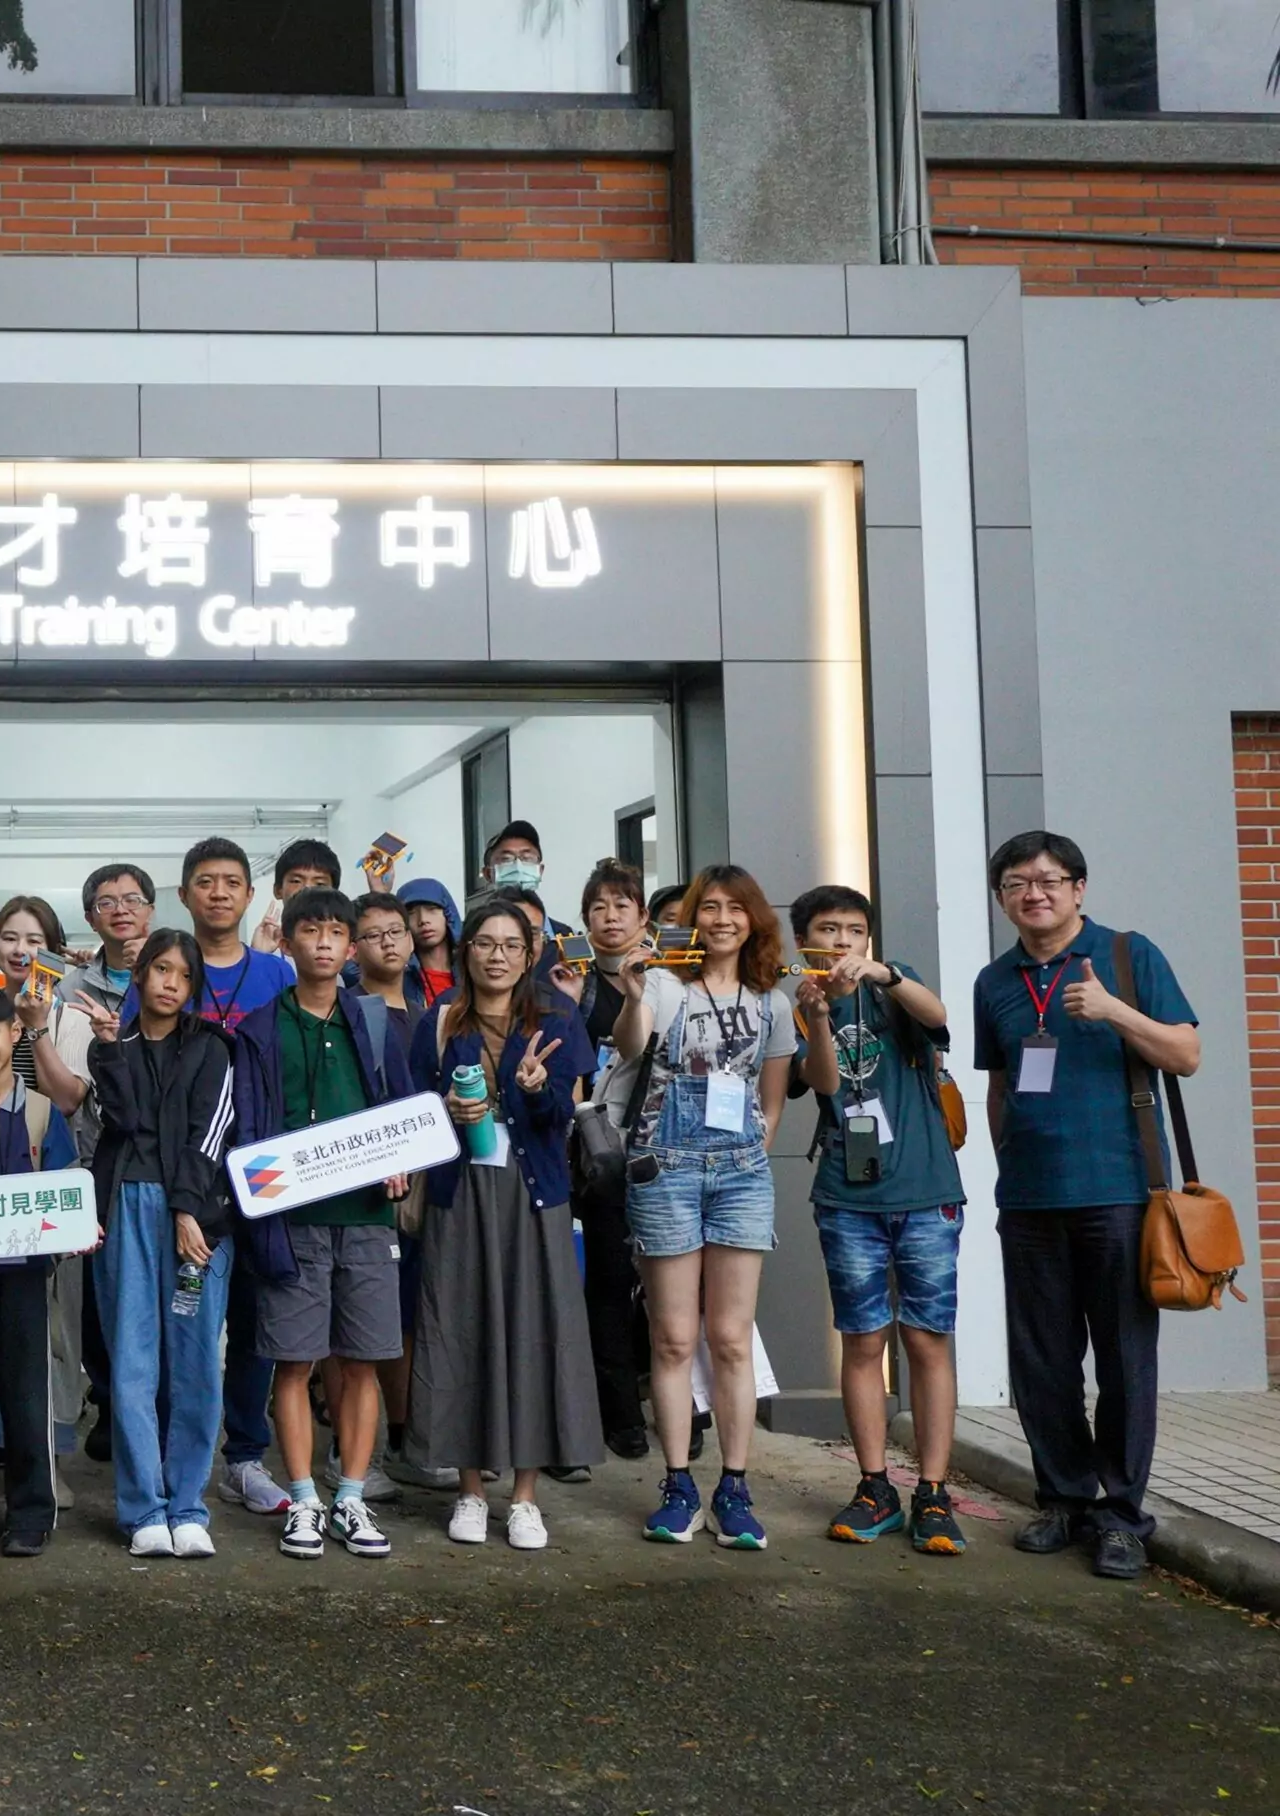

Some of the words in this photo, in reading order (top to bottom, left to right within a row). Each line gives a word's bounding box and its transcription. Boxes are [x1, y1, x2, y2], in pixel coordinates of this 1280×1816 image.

[199, 596, 356, 648] Center
[292, 1111, 436, 1167] 臺北市政府教育局
[296, 1156, 348, 1176] DEPARTMENT
[348, 1152, 359, 1161] OF
[363, 1138, 410, 1157] EDUCATION
[299, 1171, 324, 1184] TAIPEI
[324, 1164, 344, 1176] CITY
[344, 1150, 399, 1170] GOVERNMENT
